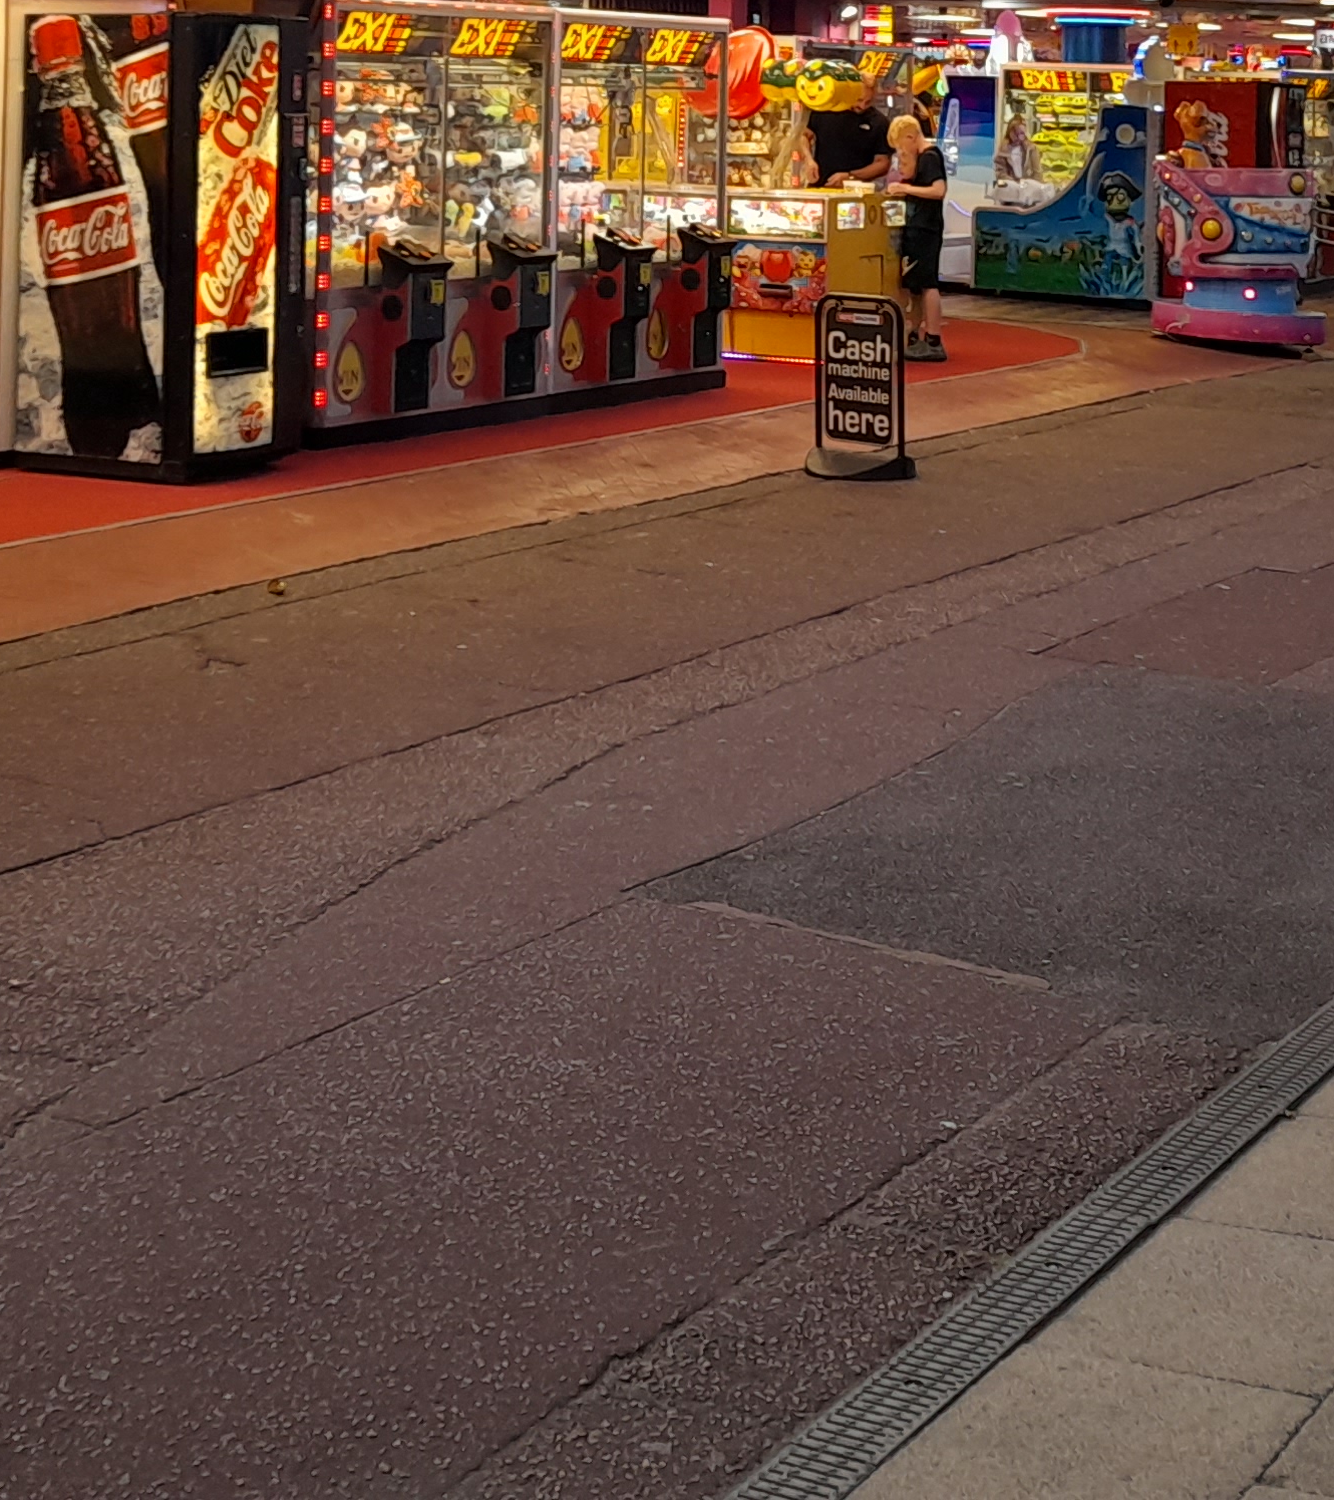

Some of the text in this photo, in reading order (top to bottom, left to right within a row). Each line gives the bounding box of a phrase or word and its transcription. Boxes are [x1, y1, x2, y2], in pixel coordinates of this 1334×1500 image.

[214, 40, 278, 158] Coke
[827, 330, 891, 363] Cash
[827, 361, 890, 382] machine
[827, 381, 890, 405] Available
[827, 401, 890, 438] here
